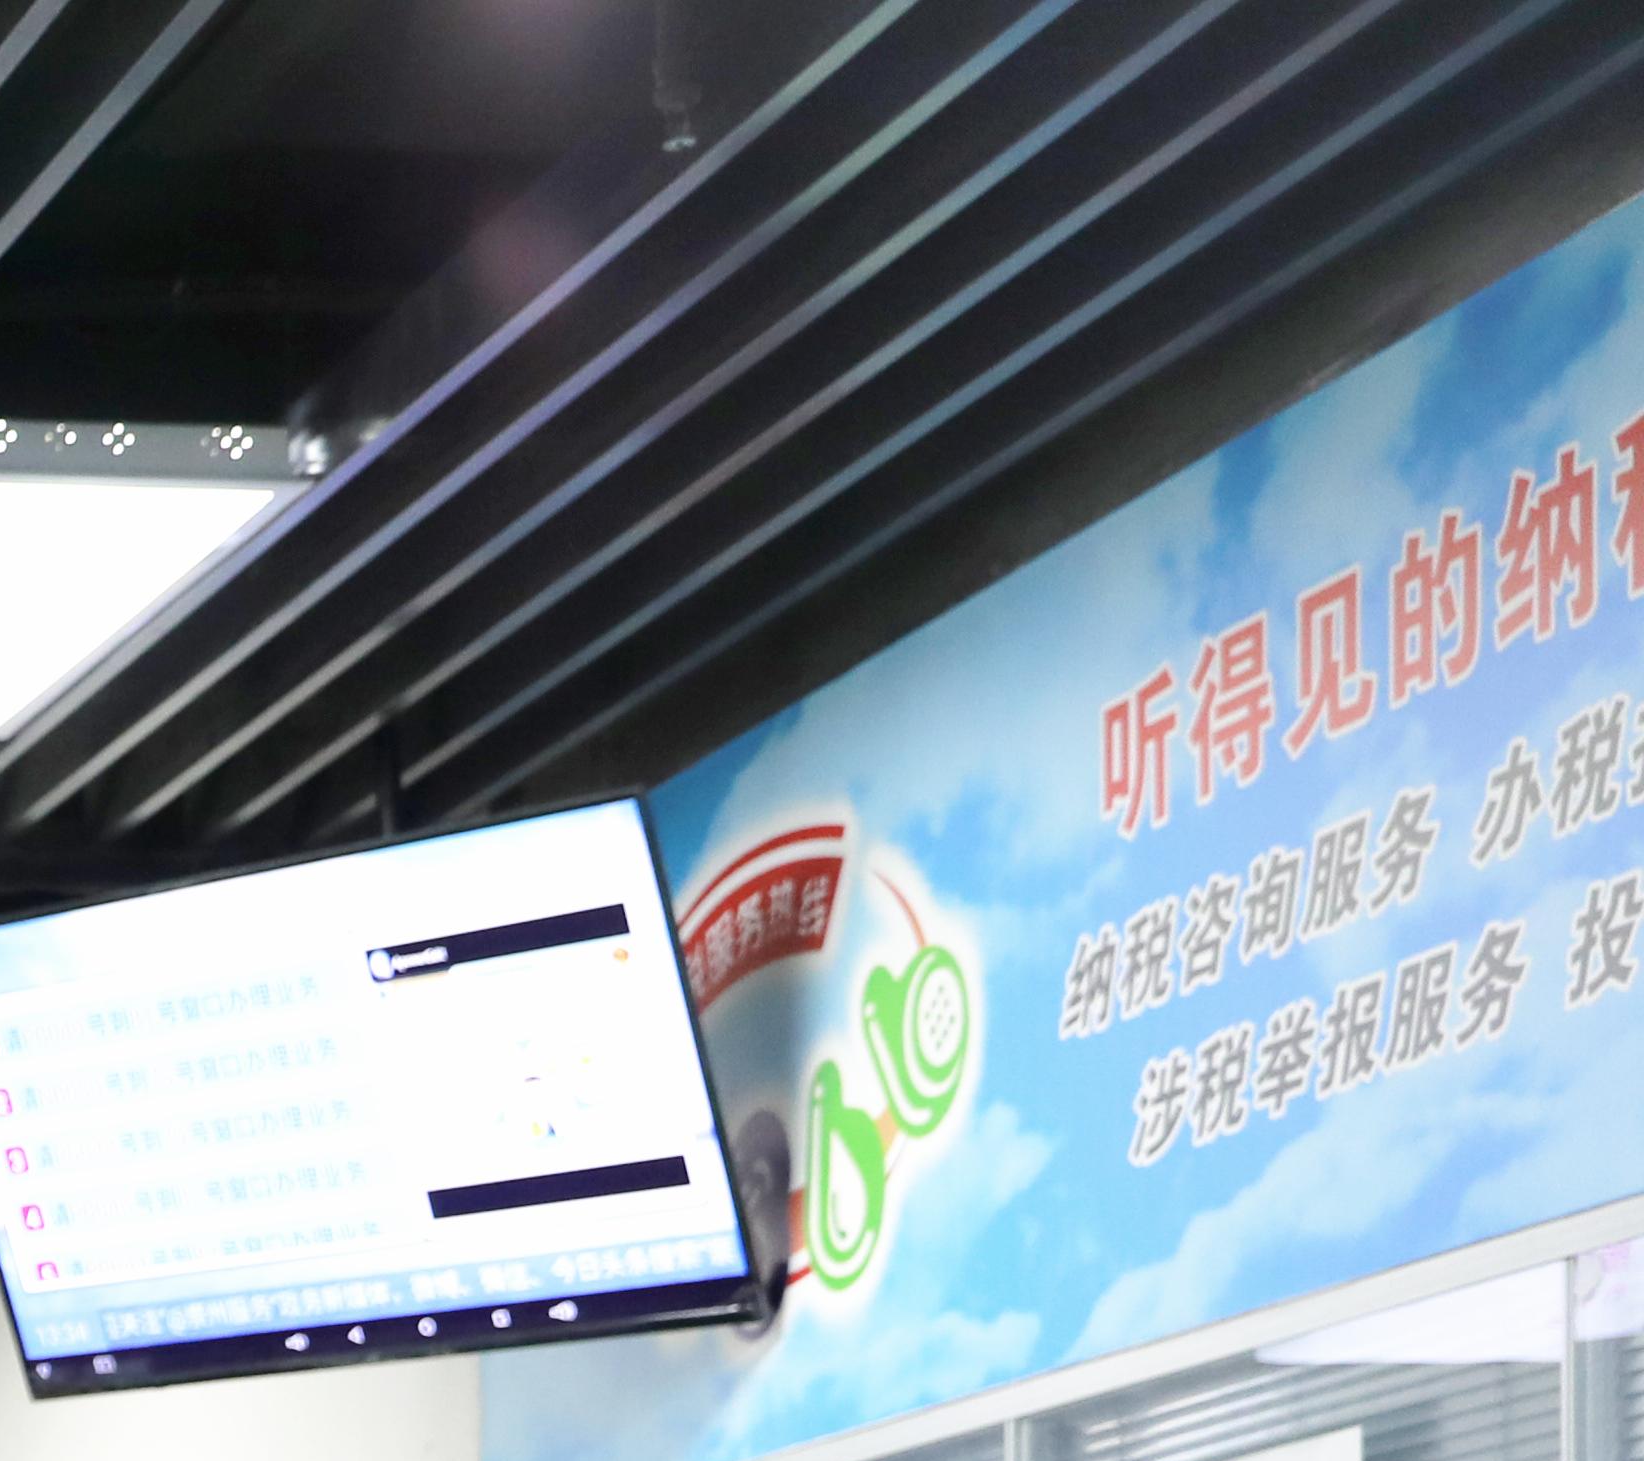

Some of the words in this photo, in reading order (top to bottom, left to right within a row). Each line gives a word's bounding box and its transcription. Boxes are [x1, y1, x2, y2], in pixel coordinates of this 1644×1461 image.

[1061, 786, 1436, 1038] 纳税咨询服务
[1128, 921, 1527, 1166] 涉税举报服务
